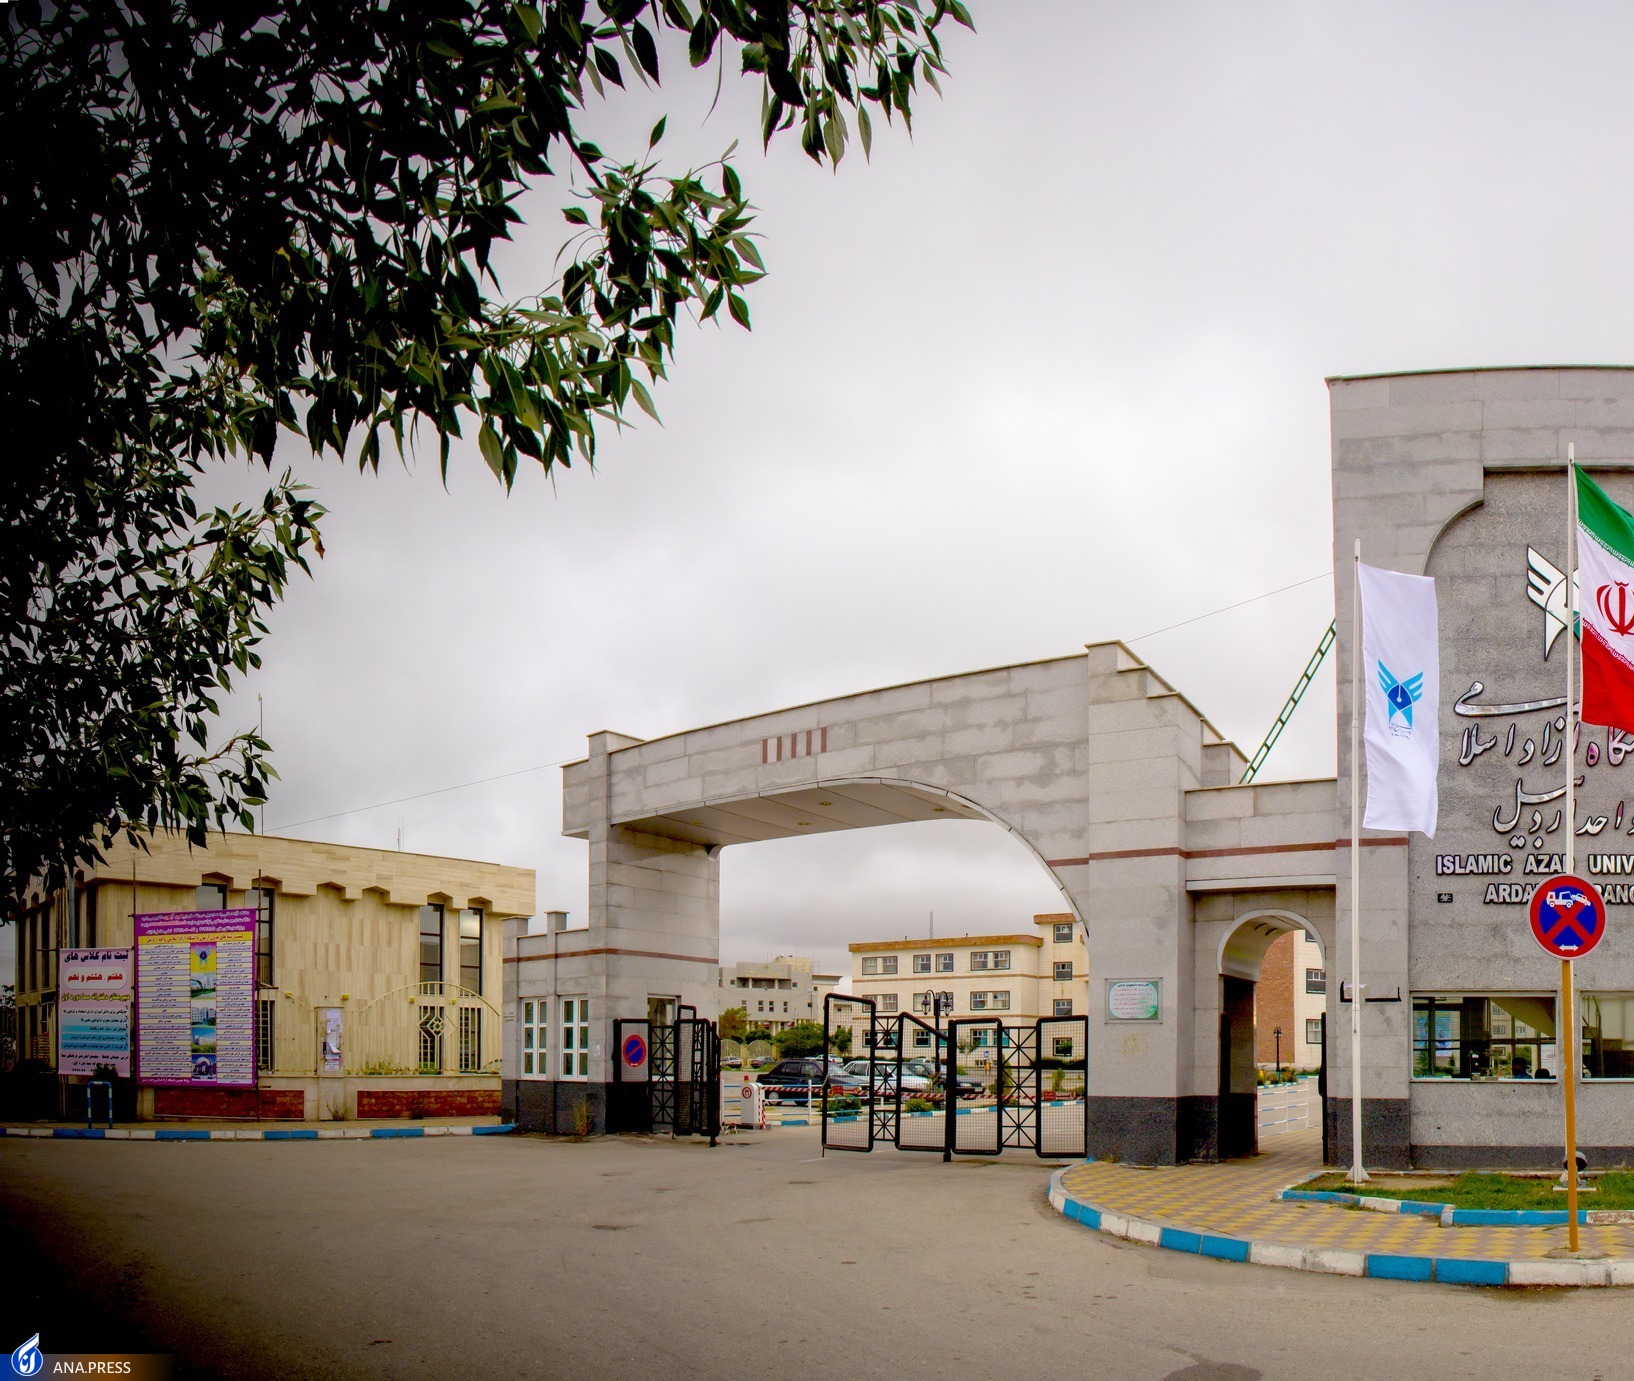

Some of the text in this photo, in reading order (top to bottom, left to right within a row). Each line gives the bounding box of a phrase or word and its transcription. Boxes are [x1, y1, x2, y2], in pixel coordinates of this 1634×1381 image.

[1436, 853, 1513, 876] ISLAMIC
[1484, 883, 1539, 905] ARDA
[64, 950, 129, 962] ثبت نام کلاس های
